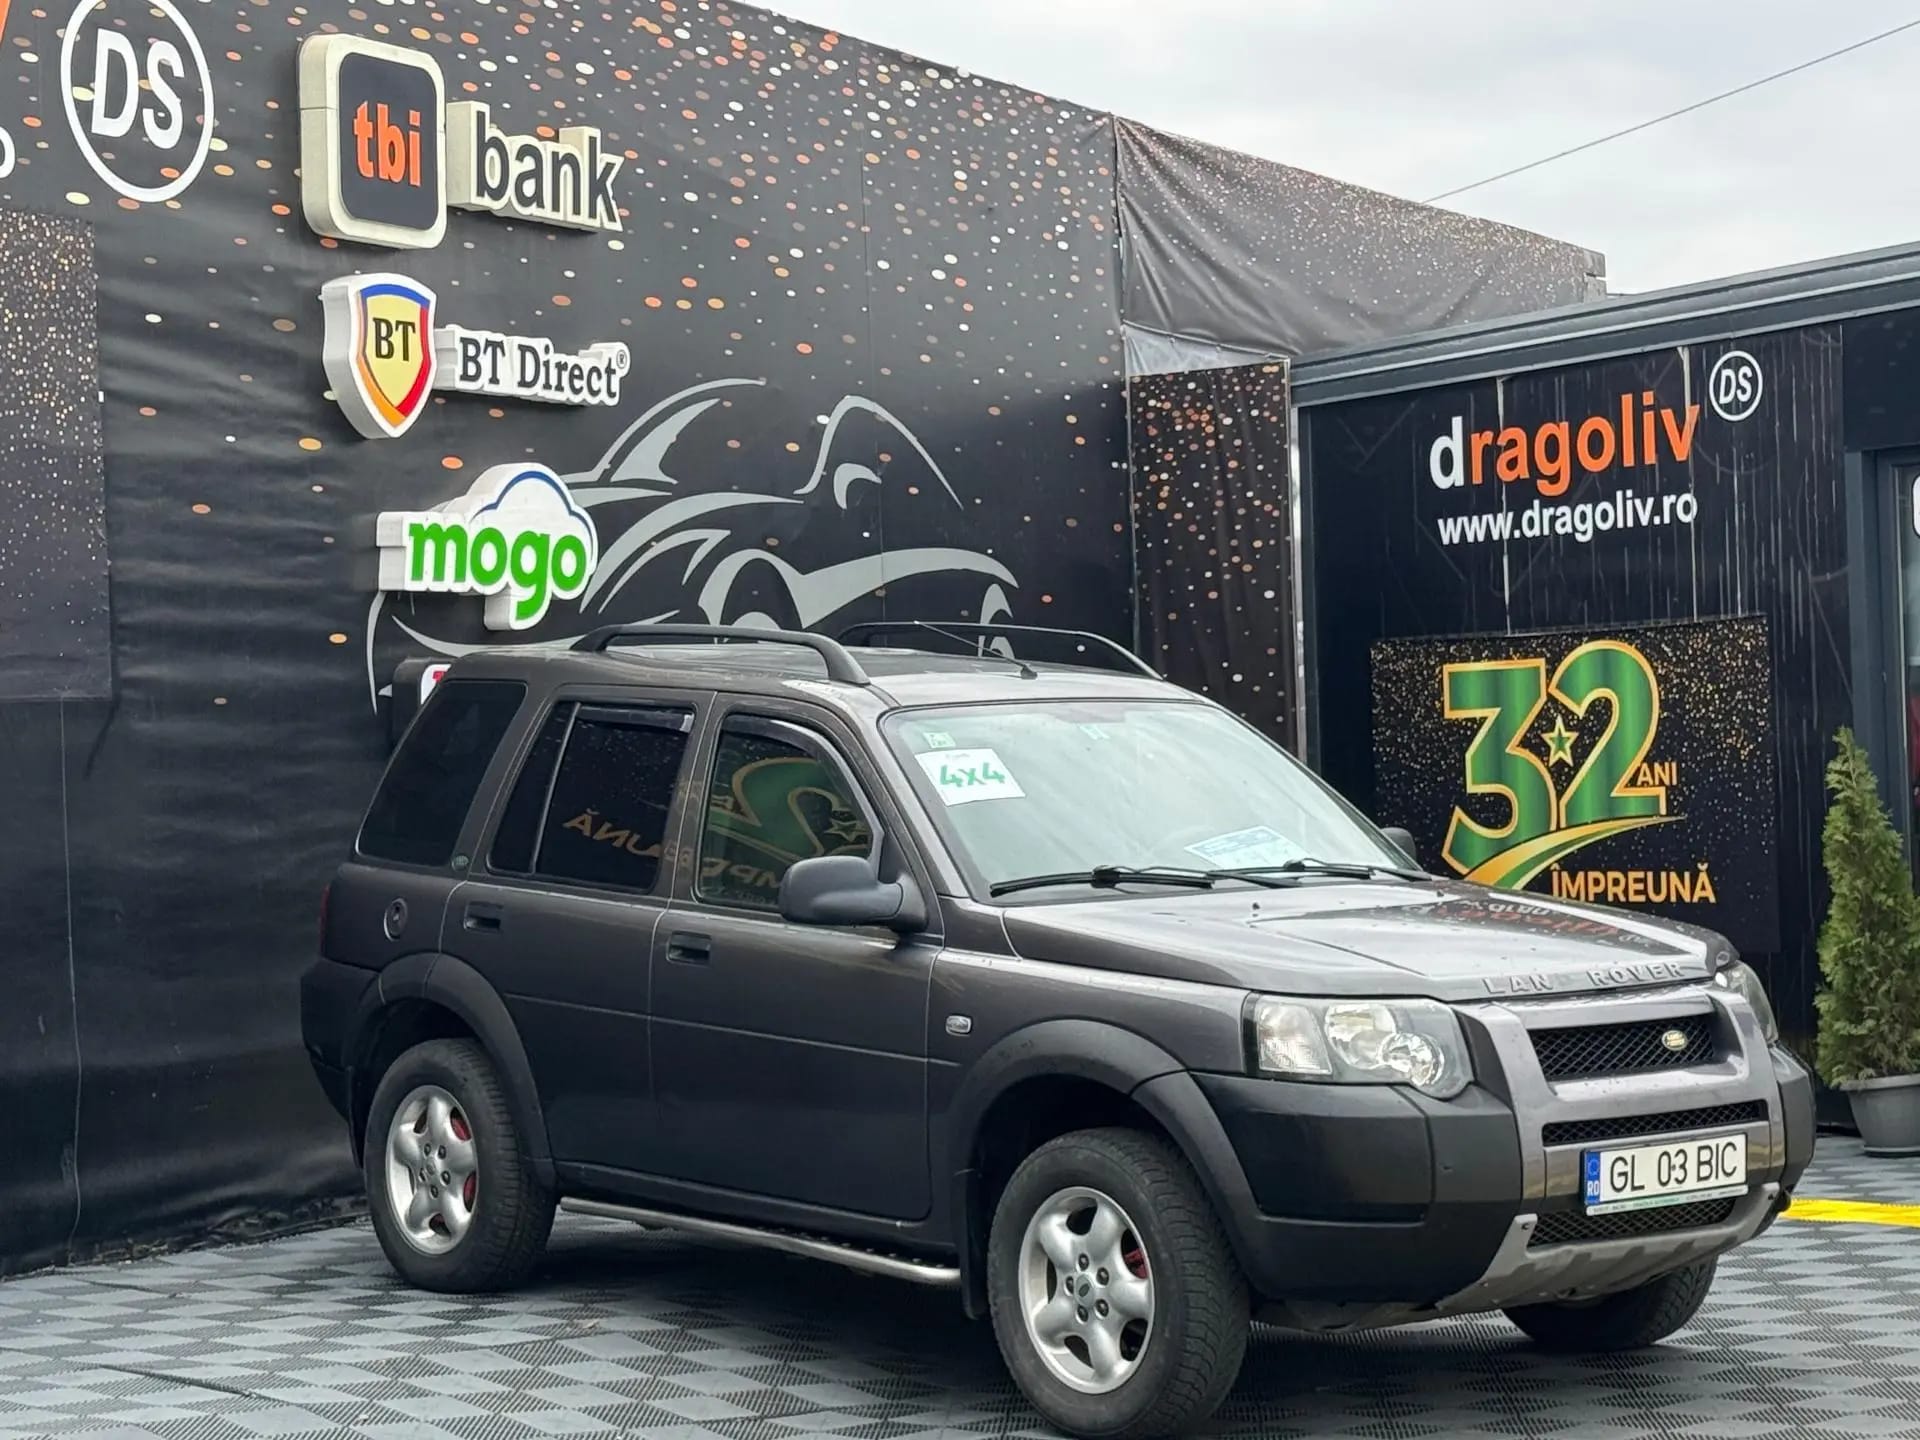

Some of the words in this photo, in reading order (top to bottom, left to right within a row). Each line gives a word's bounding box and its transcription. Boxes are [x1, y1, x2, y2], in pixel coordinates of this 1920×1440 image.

[91, 28, 185, 149] DS
[354, 101, 421, 187] tbi
[476, 110, 616, 223] bank
[373, 317, 416, 362] BT
[459, 337, 506, 385] BT
[1719, 365, 1753, 404] DS
[1429, 391, 1700, 496] dragoliv
[1438, 489, 1698, 545] www.dragoliv.ro
[409, 522, 587, 621] mogo
[1441, 640, 1667, 876] 32
[1636, 761, 1678, 786] ANI
[1551, 862, 1717, 904] ÎMPREUNĂ
[1587, 962, 1686, 987] ROVER
[1610, 1154, 1645, 1193] GL
[1697, 1142, 1738, 1182] BIC
